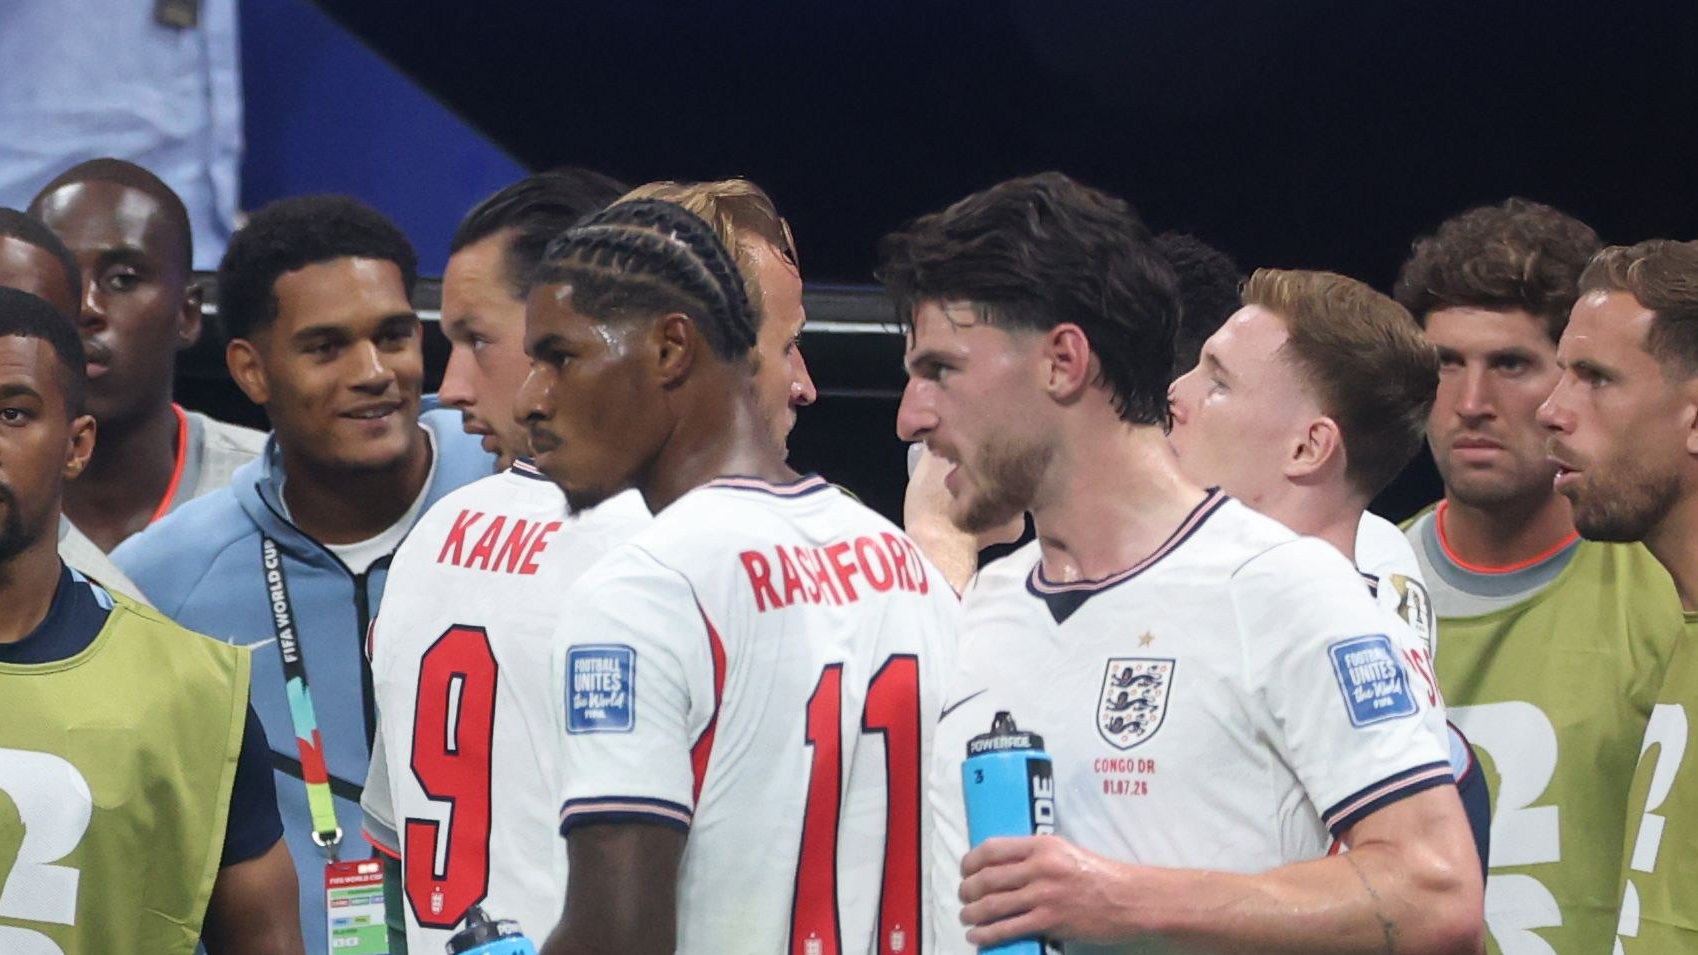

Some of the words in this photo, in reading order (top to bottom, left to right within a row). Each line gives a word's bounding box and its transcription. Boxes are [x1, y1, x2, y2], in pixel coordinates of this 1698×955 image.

[436, 508, 563, 575] KANE
[739, 532, 929, 613] RASHFORD
[268, 570, 290, 628] WORLD
[280, 627, 298, 663] FIFA
[574, 673, 622, 692] UNITES
[1349, 660, 1396, 686] UNITES
[404, 623, 499, 930] 9
[974, 769, 984, 784] 3
[1094, 757, 1134, 773] CONGO
[1138, 757, 1156, 774] DR
